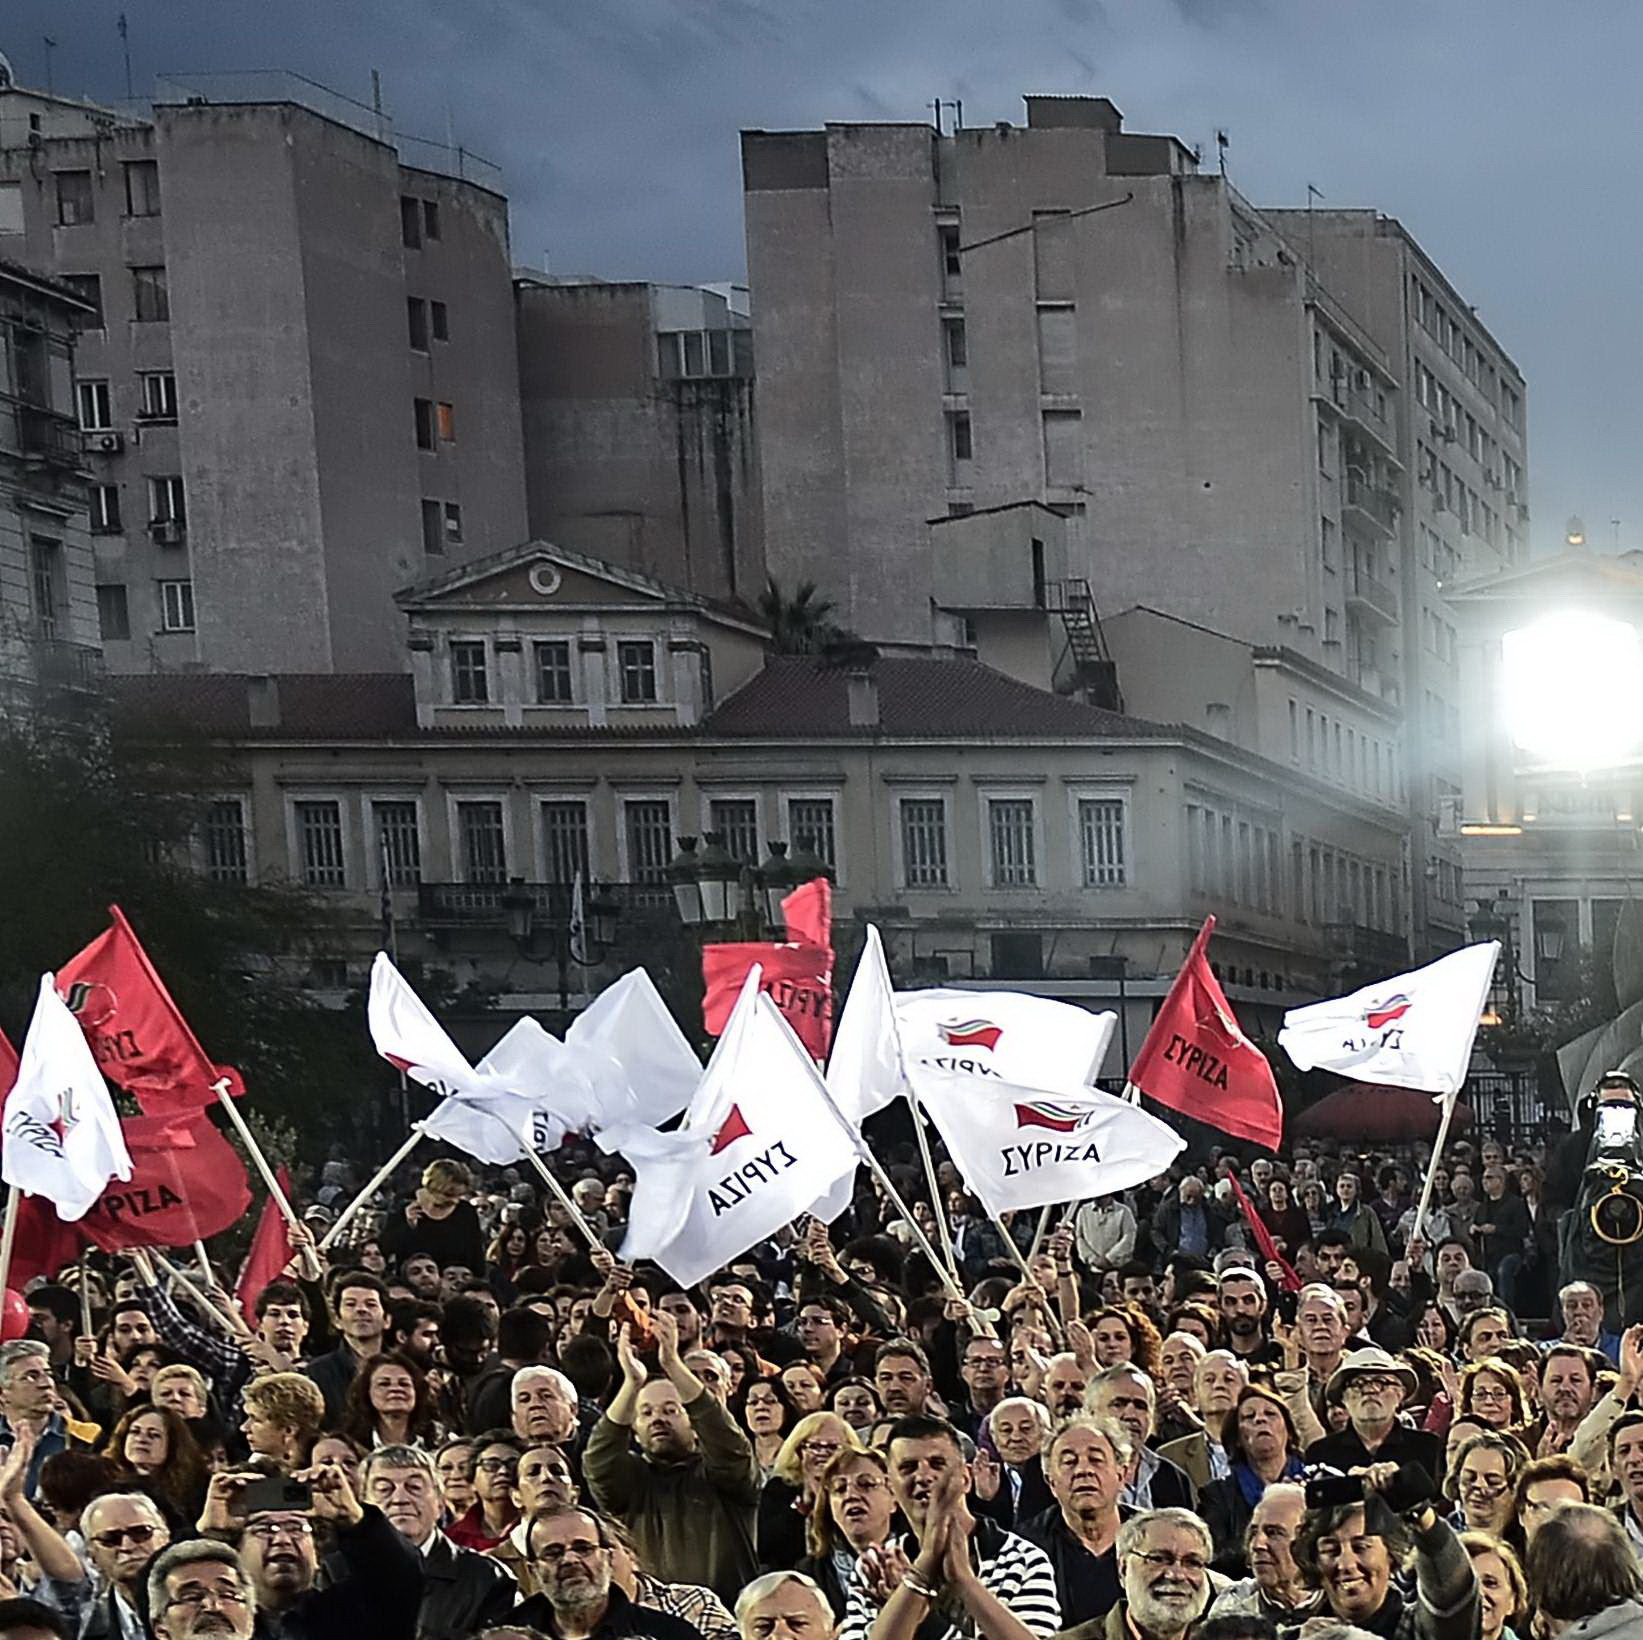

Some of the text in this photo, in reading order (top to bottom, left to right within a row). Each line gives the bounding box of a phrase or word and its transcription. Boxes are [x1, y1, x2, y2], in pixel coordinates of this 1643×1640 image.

[1163, 1034, 1229, 1091] ΣΥΡΙΖΑ
[1001, 1142, 1101, 1176] ΣΥΡΙΖΑ
[105, 1184, 182, 1221] ΡΙΖΑ
